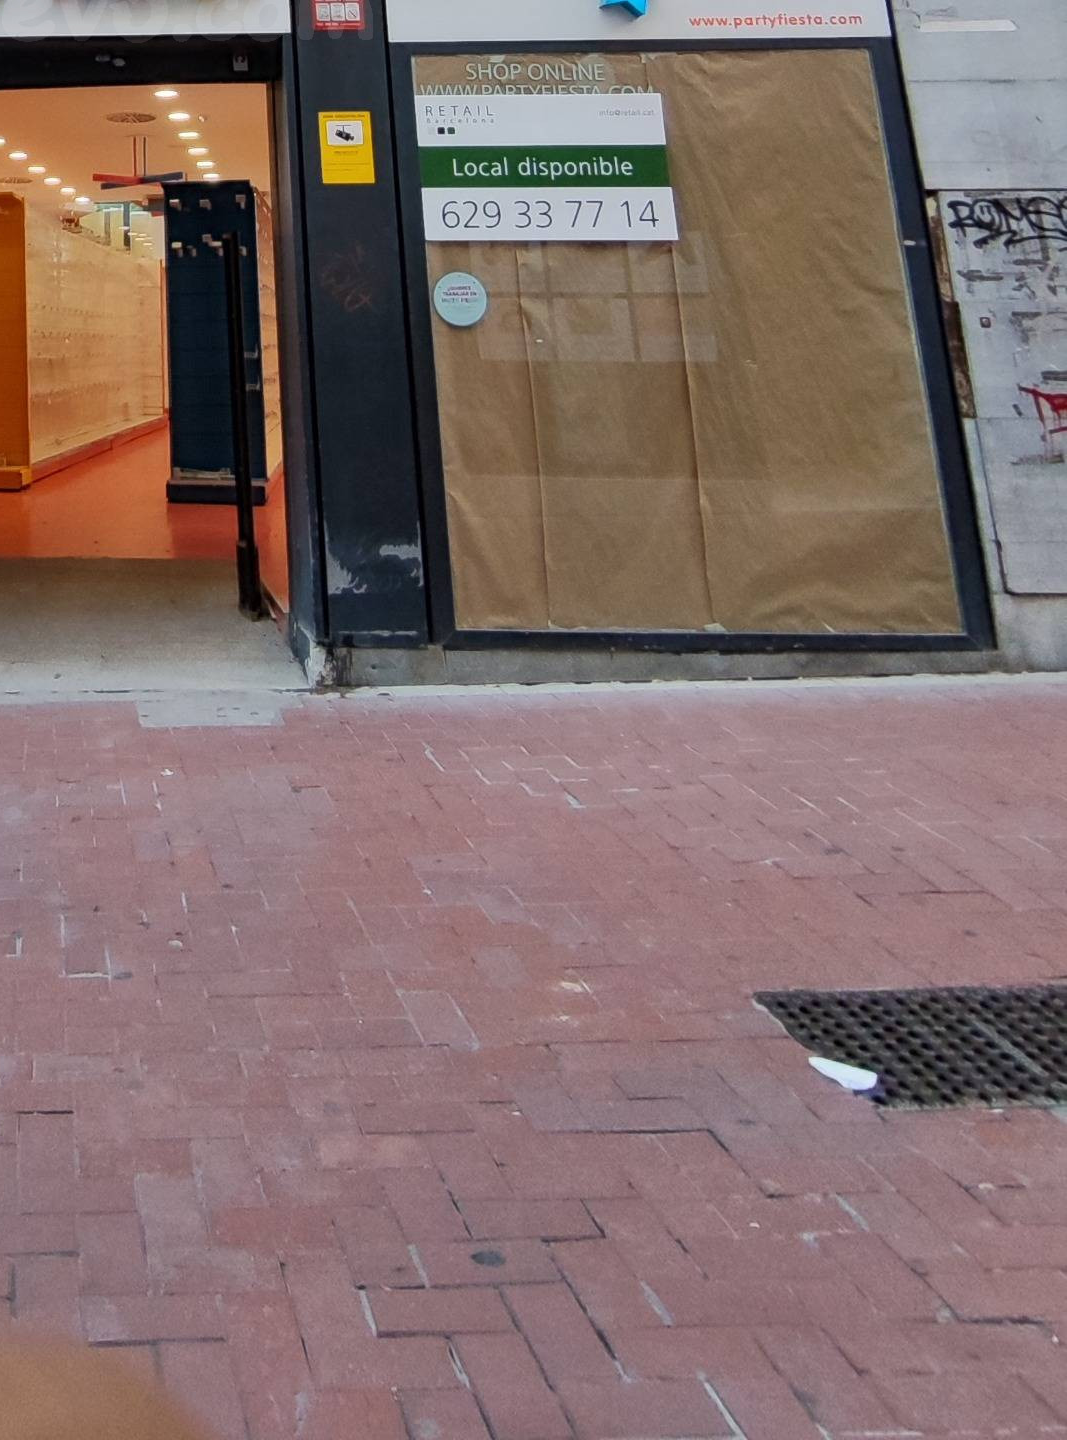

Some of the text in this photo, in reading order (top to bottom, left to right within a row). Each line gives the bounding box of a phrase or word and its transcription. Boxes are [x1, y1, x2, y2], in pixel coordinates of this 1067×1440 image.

[689, 13, 863, 29] www.partyfiesta.com
[466, 63, 606, 81] SHOP ONLINE
[425, 105, 495, 117] RETAIL
[452, 156, 634, 180] Local disponible
[442, 200, 660, 228] 629 33 77 14
